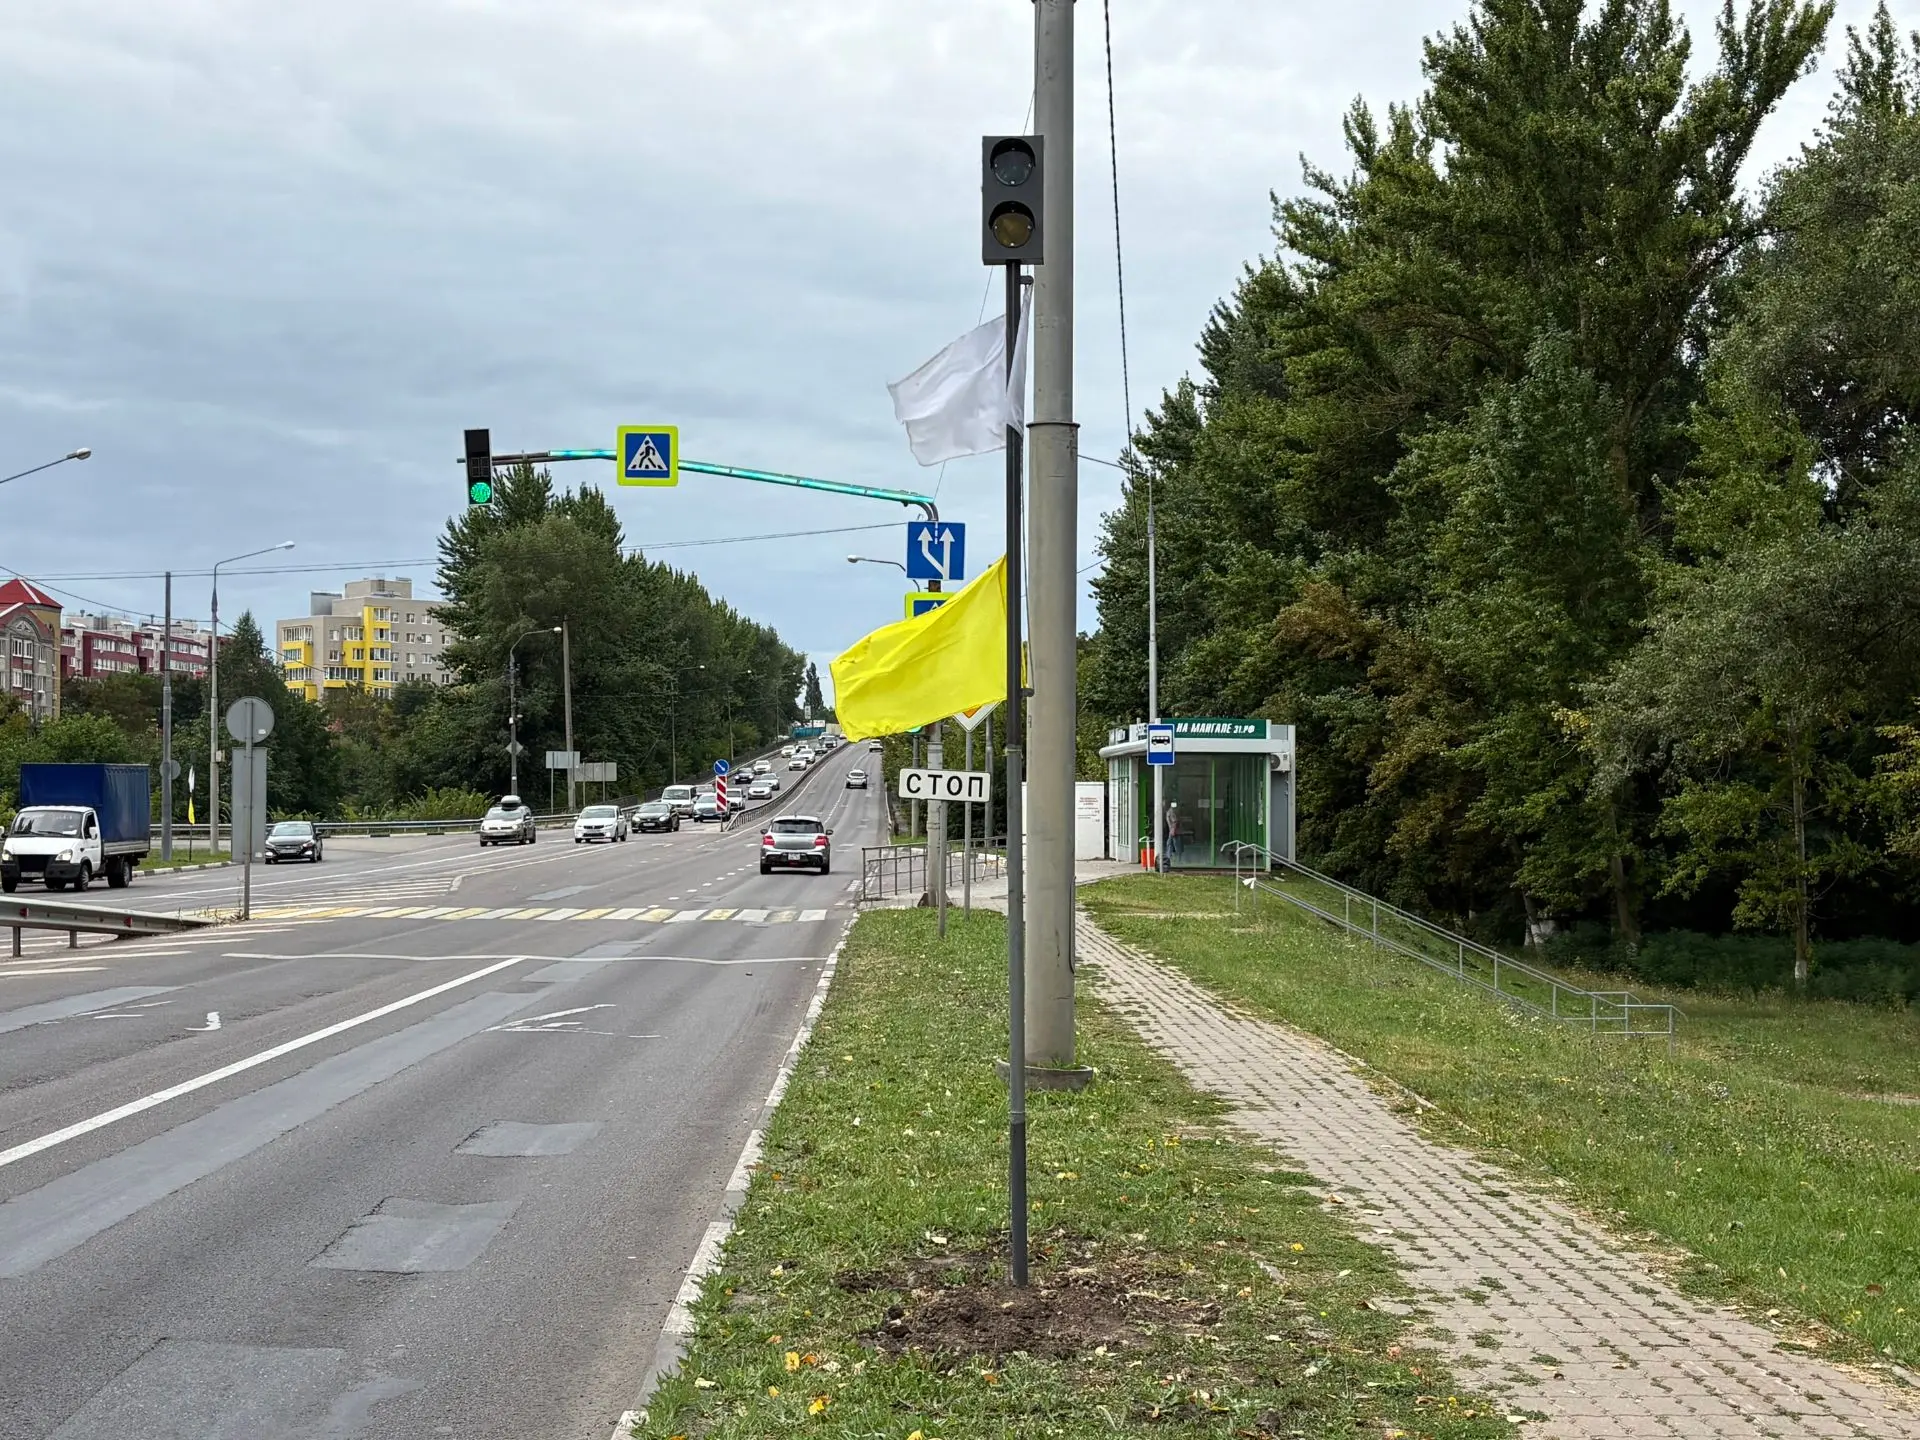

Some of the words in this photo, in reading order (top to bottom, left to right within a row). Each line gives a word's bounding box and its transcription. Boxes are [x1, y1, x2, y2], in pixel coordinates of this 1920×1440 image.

[1176, 722, 1189, 732] НА
[1190, 722, 1233, 734] МАНГАЛЕ
[906, 773, 983, 797] СТОП
